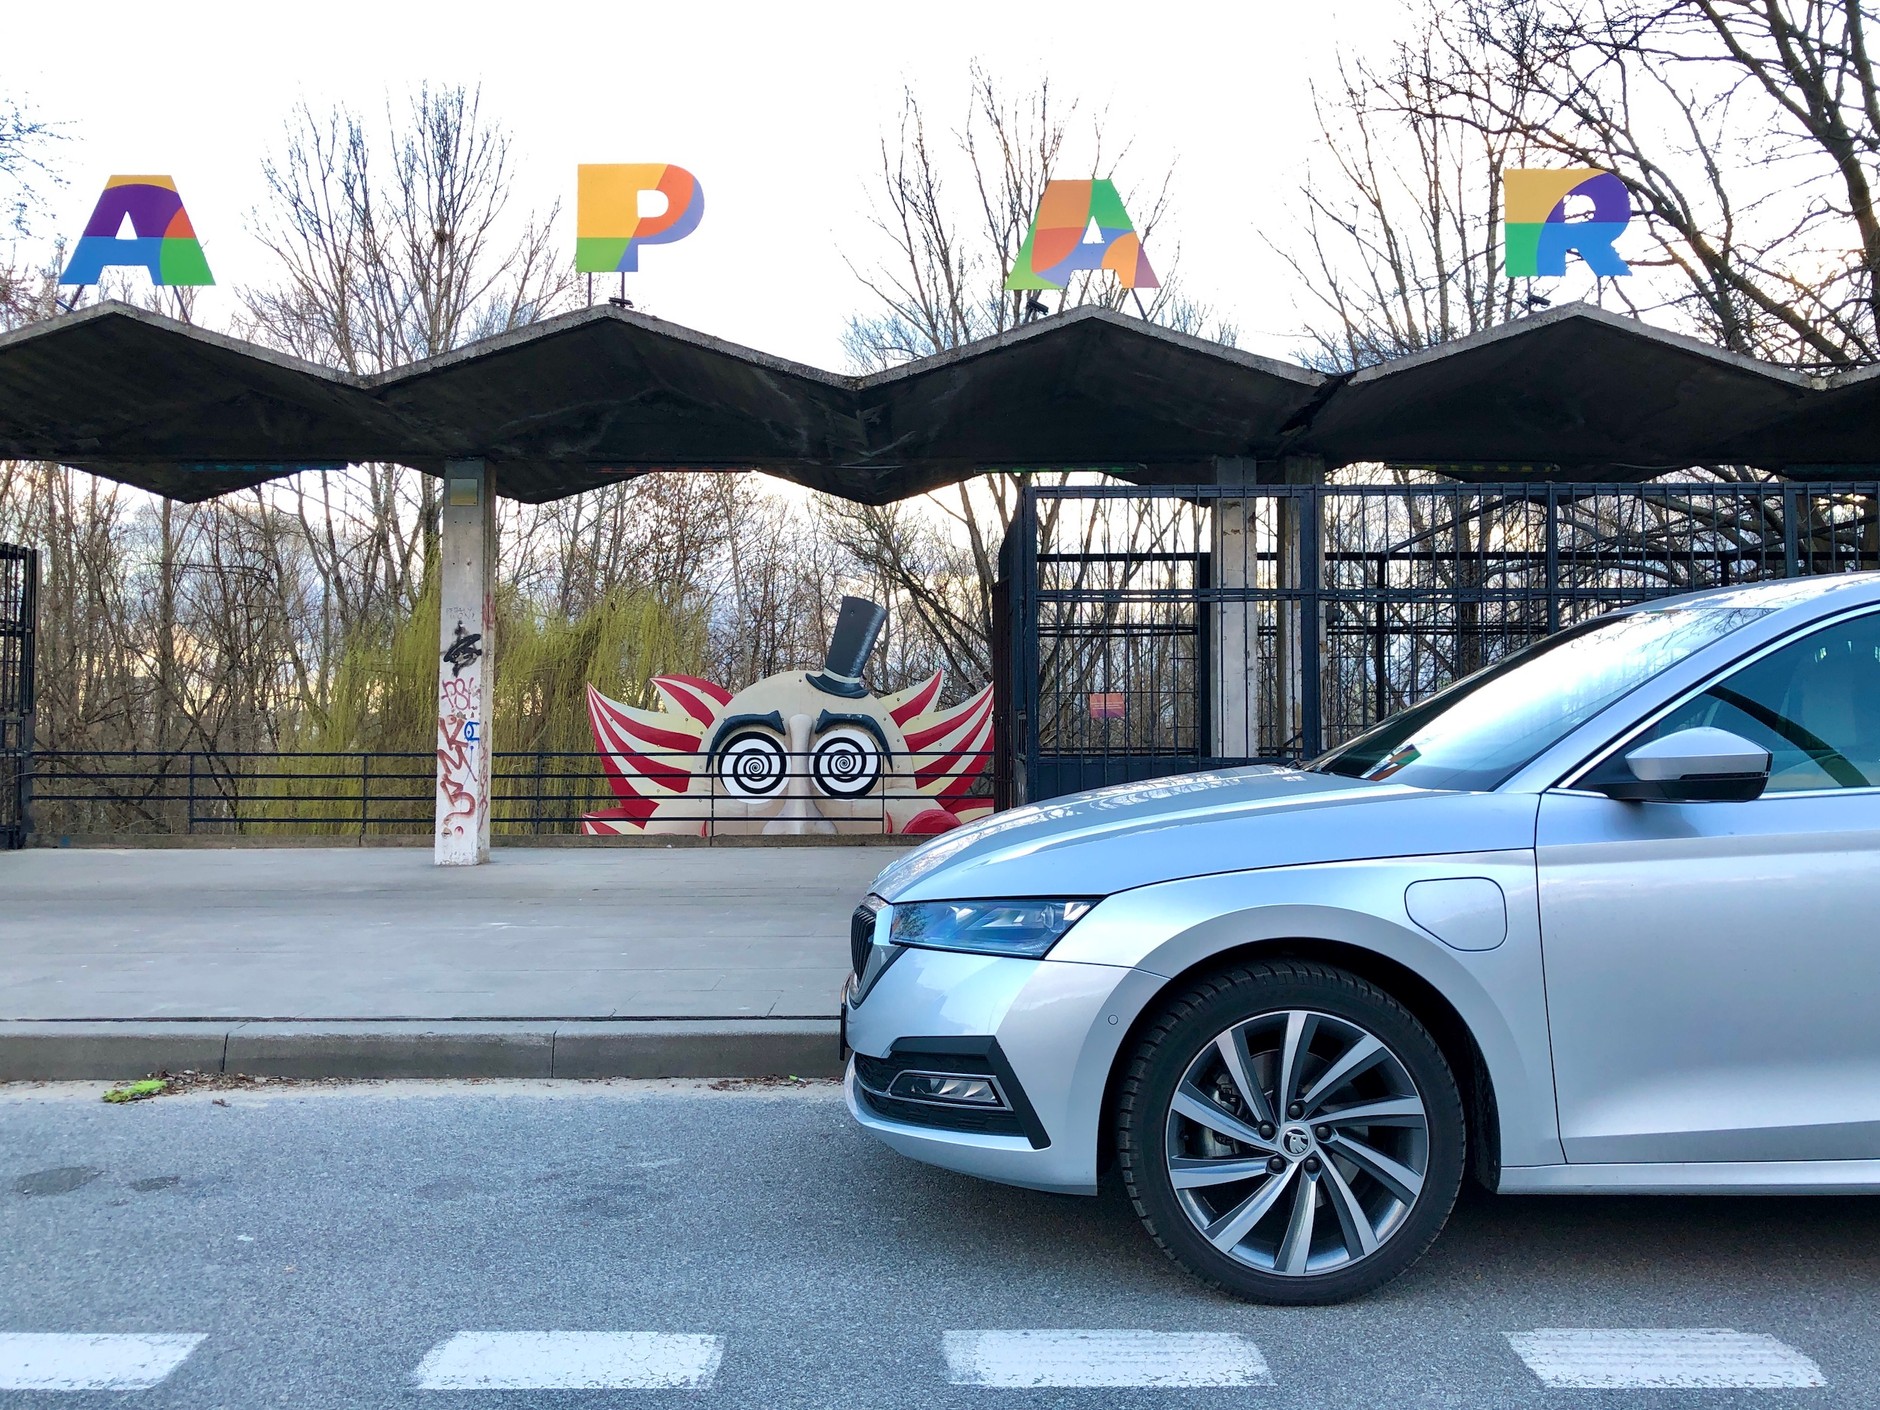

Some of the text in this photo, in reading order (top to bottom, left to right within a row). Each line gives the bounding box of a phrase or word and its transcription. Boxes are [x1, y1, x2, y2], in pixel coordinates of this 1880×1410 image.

[59, 164, 1633, 290] A P A R
